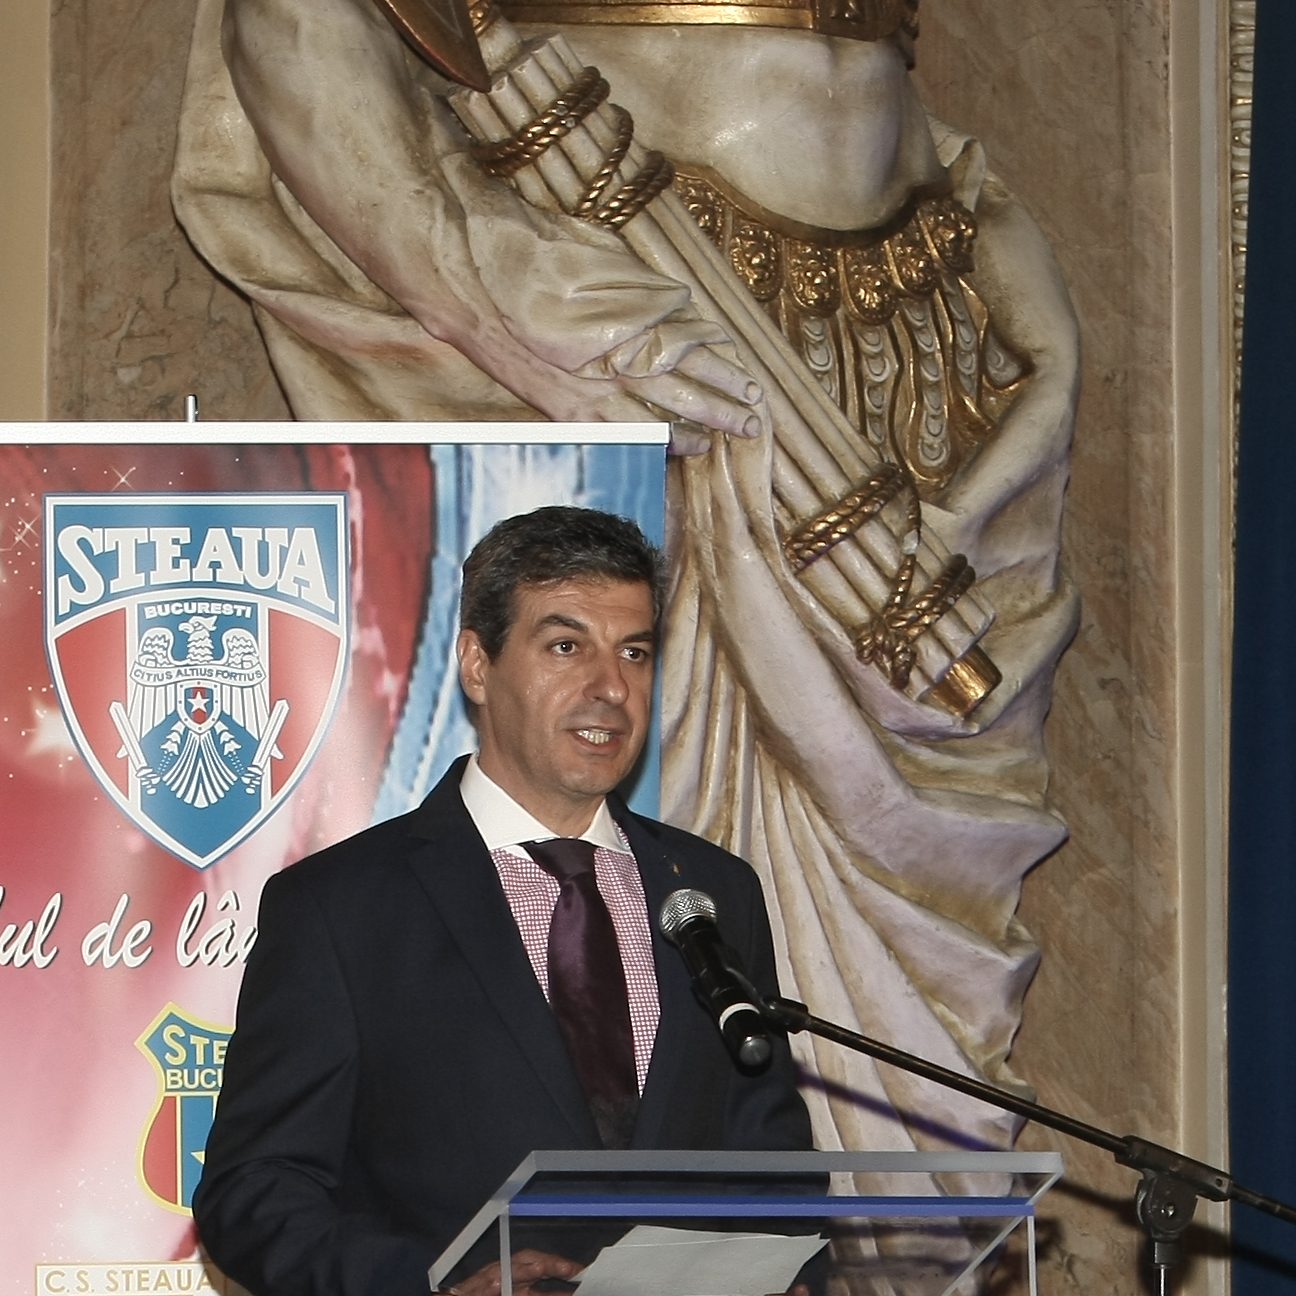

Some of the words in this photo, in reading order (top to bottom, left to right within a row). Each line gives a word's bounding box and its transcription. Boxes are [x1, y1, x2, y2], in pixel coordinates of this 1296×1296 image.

[57, 525, 336, 616] STEAUA
[144, 601, 252, 619] BUCURESTI
[133, 668, 173, 682] CITIUS
[175, 667, 214, 679] ALTIUS
[215, 669, 263, 682] FORTIUS
[81, 893, 153, 969] de
[106, 1269, 217, 1293] STEAUA
